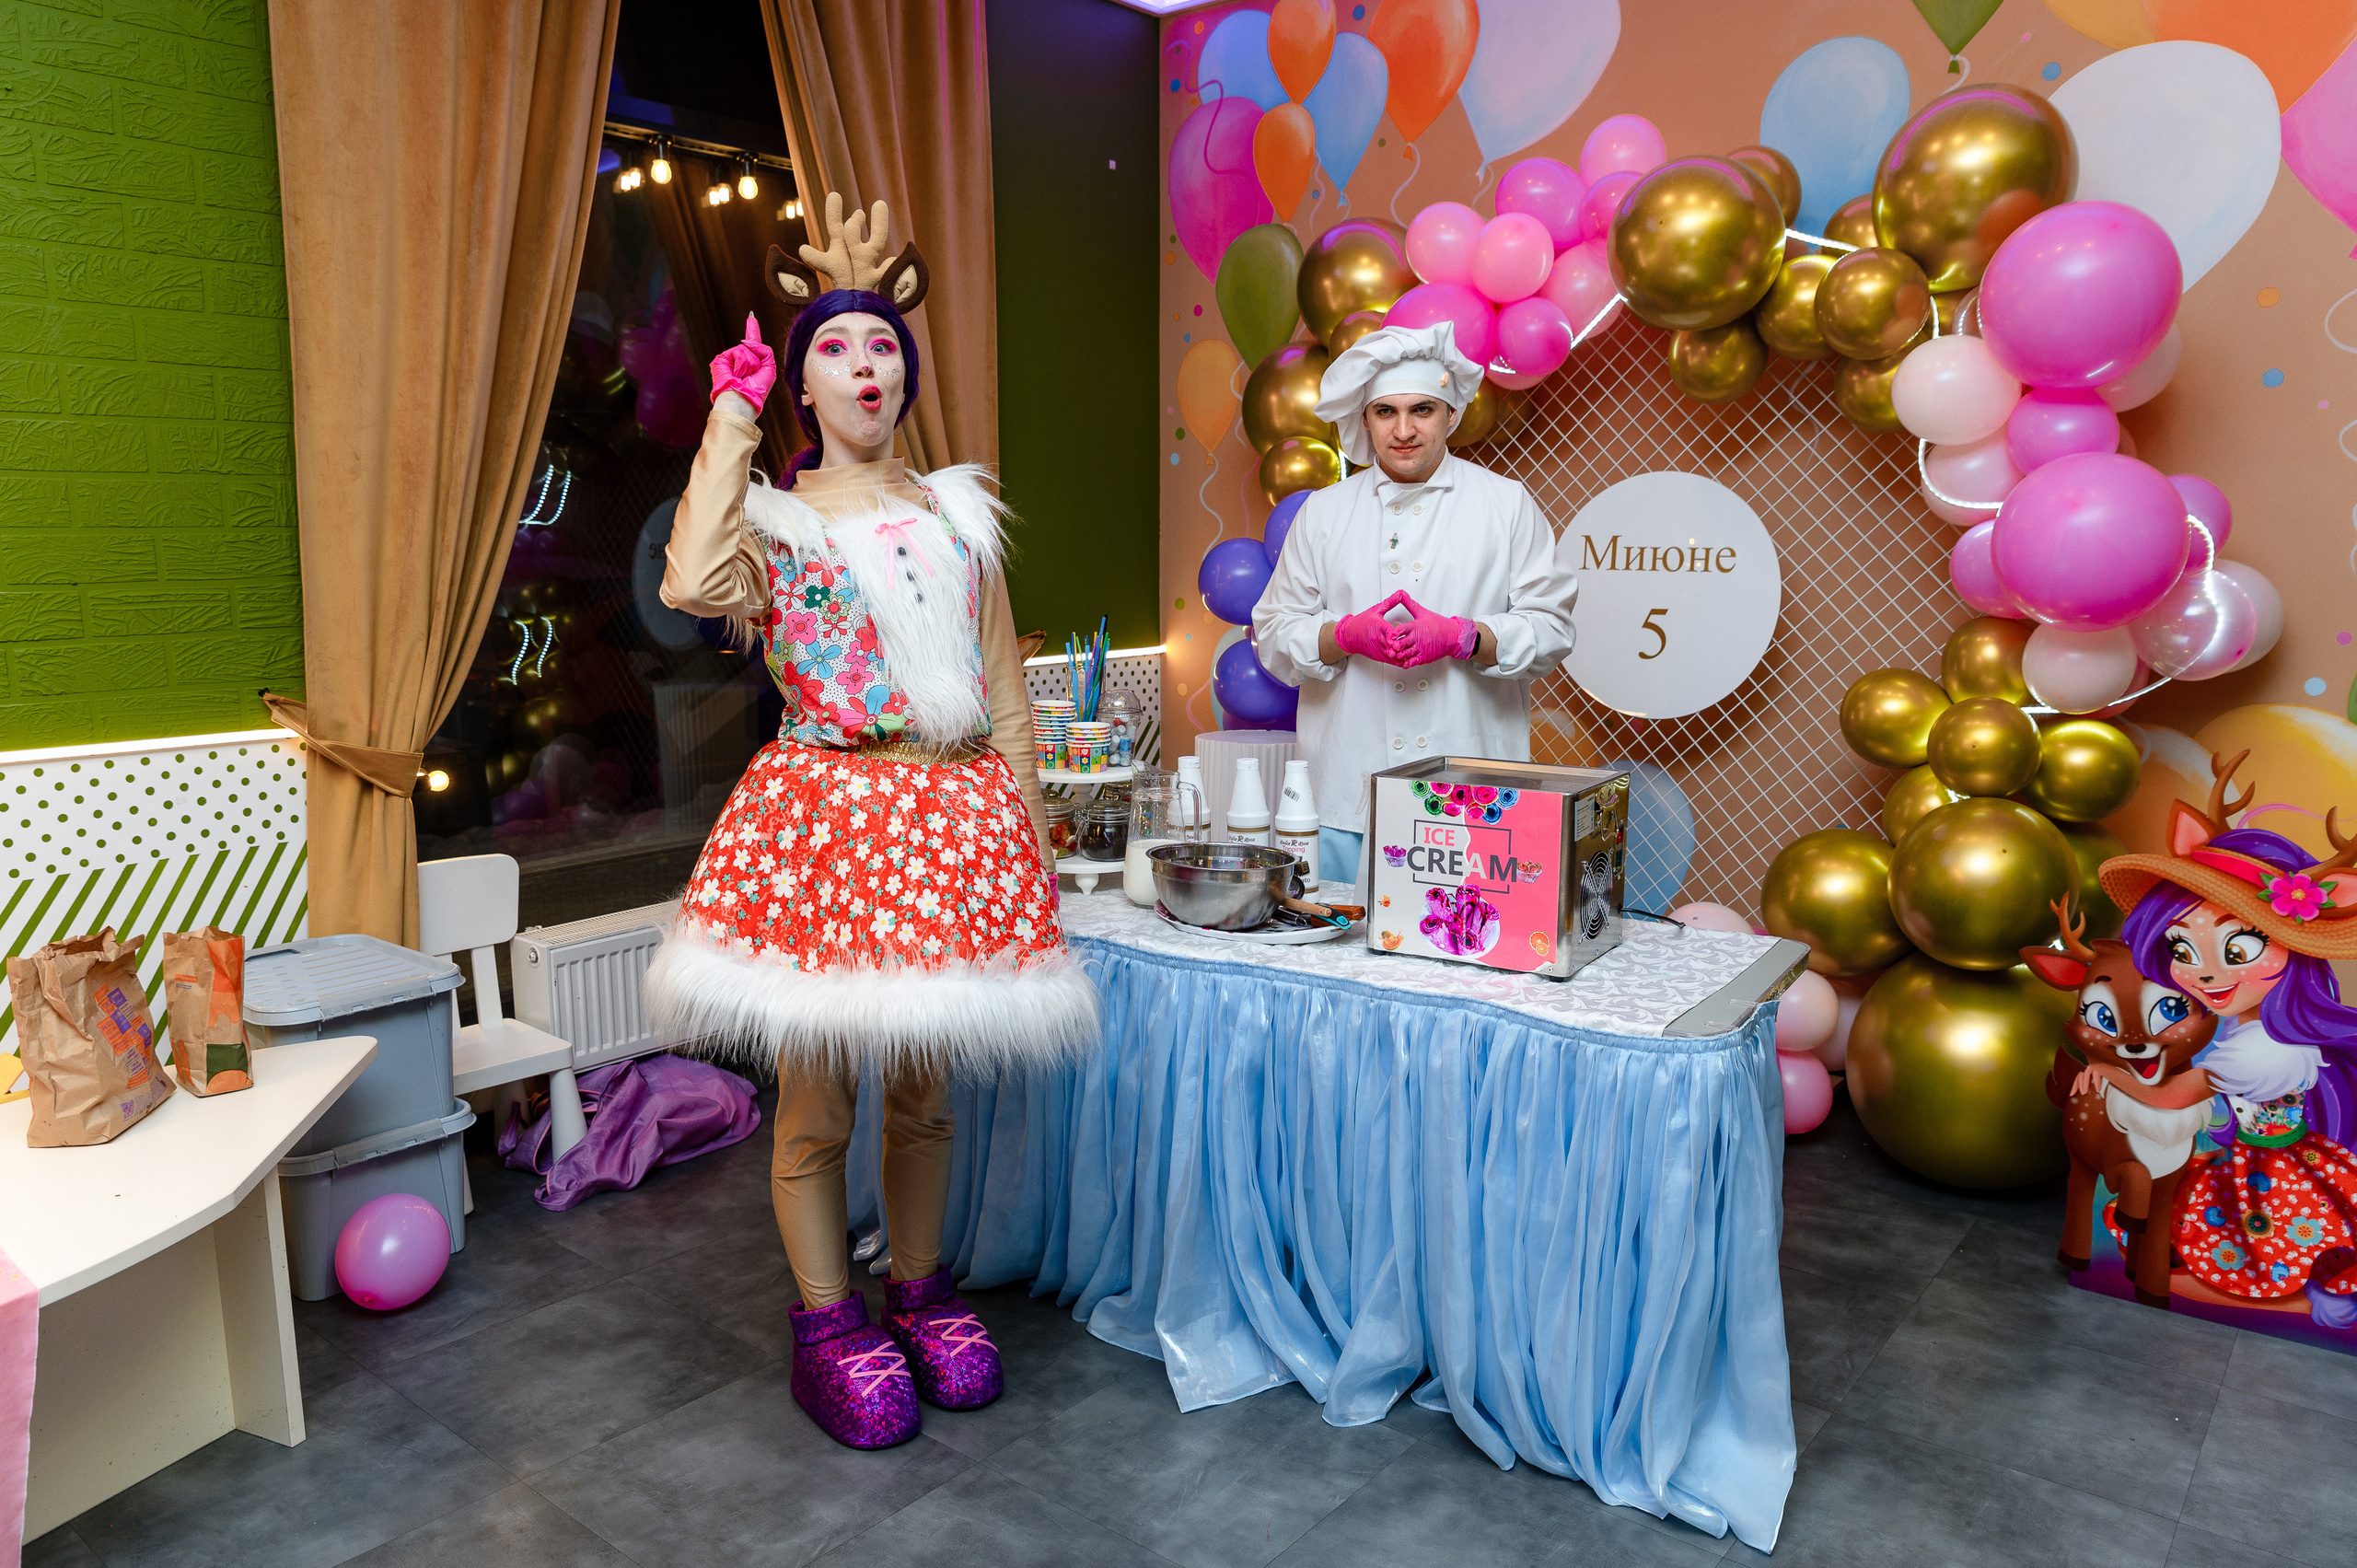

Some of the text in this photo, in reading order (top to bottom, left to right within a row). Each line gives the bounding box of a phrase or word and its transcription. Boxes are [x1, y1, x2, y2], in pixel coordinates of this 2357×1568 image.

[1578, 535, 1736, 574] Миюне
[1638, 609, 1668, 659] 5
[1283, 845, 1306, 854] Topping
[1423, 827, 1455, 847] ICE
[1407, 845, 1518, 883] CREAM
